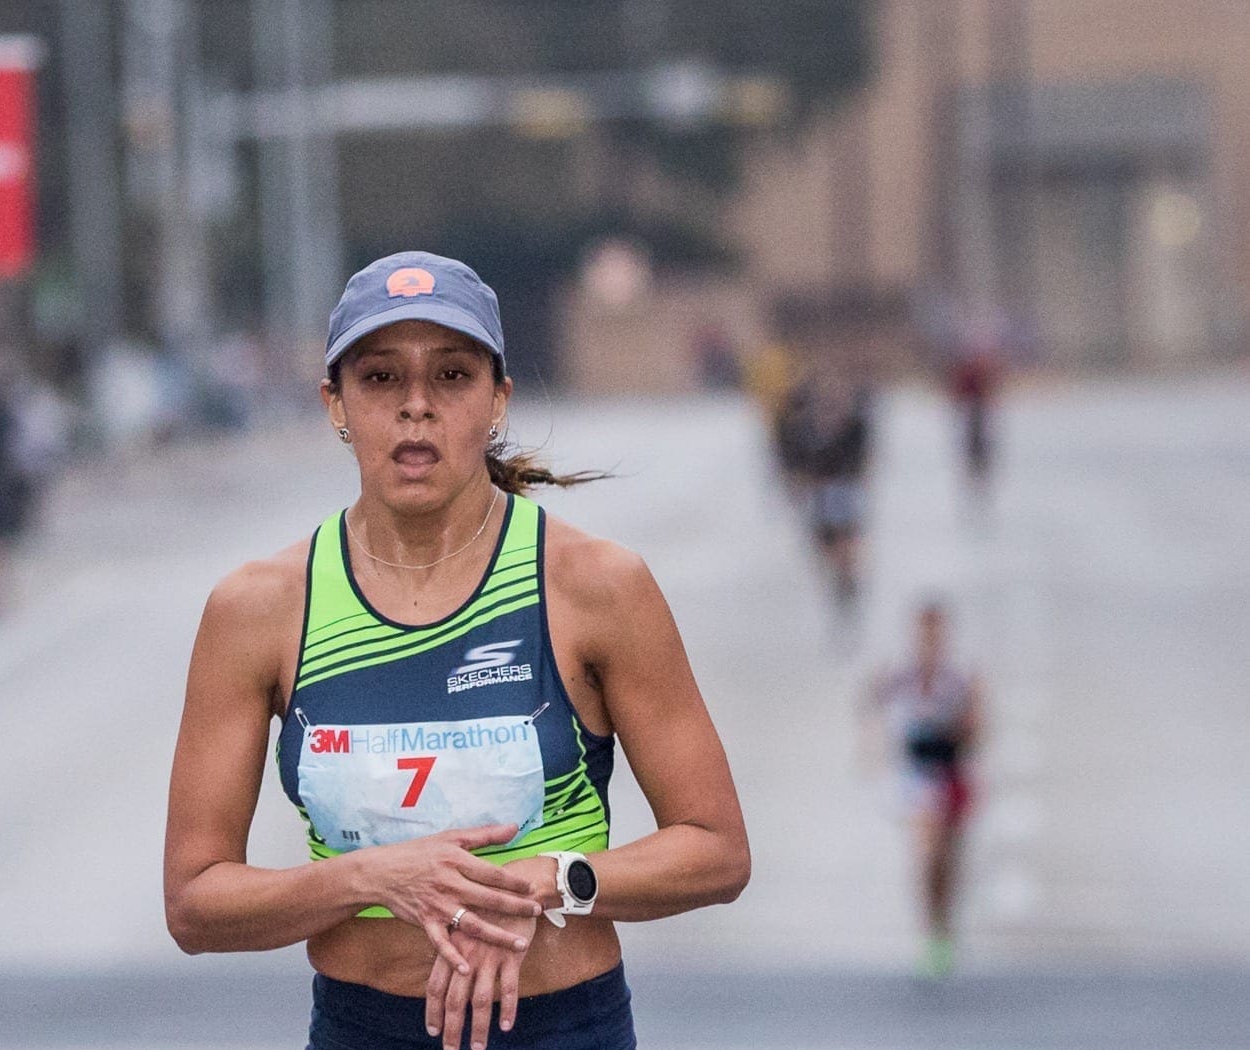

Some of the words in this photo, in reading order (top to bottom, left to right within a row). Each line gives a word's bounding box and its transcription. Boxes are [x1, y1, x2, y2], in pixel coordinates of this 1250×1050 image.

[446, 663, 532, 687] SKECHERS
[447, 673, 533, 695] PERFORMANCE
[397, 756, 438, 808] 7
